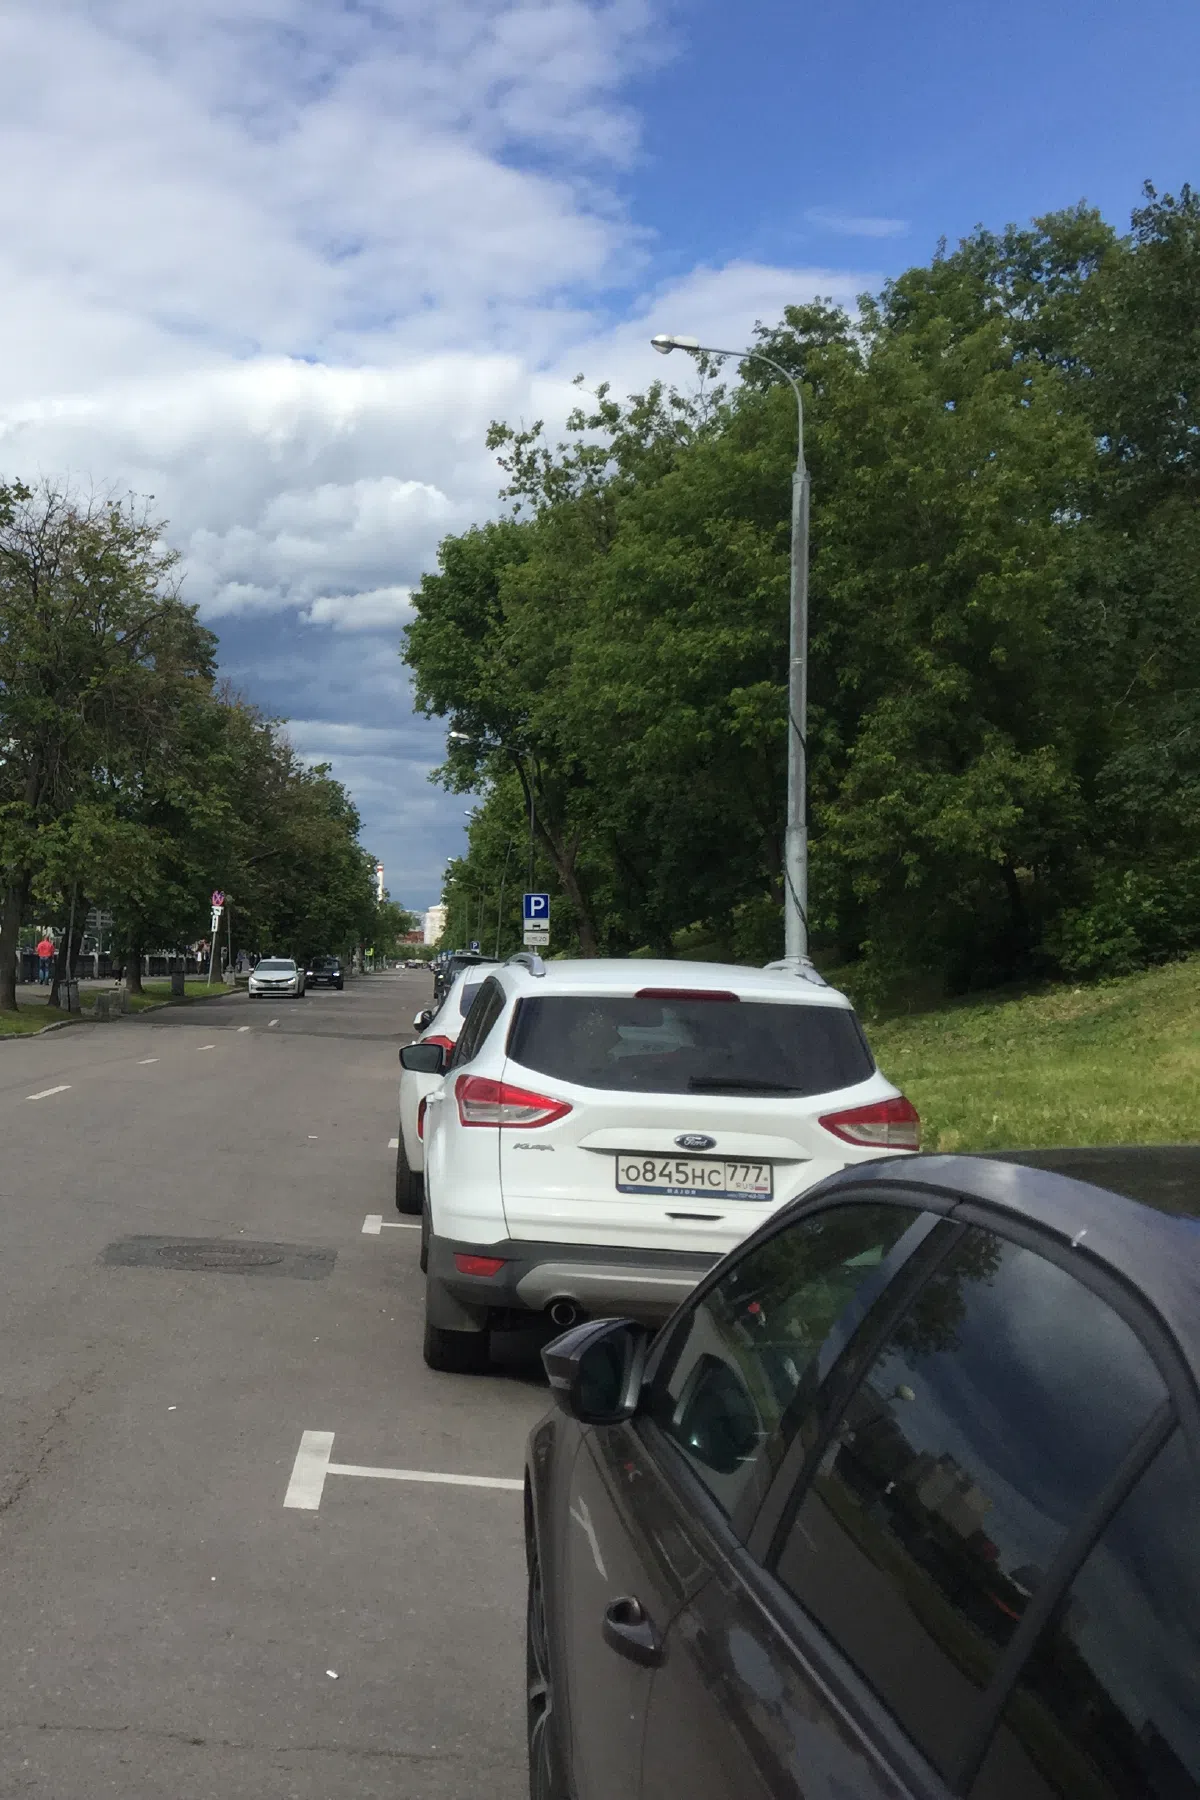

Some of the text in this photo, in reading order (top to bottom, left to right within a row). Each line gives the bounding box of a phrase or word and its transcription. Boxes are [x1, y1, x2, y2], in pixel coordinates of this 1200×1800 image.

[531, 897, 545, 916] P
[683, 1136, 708, 1147] Ford
[727, 1164, 763, 1183] 777
[736, 1182, 754, 1191] RUS
